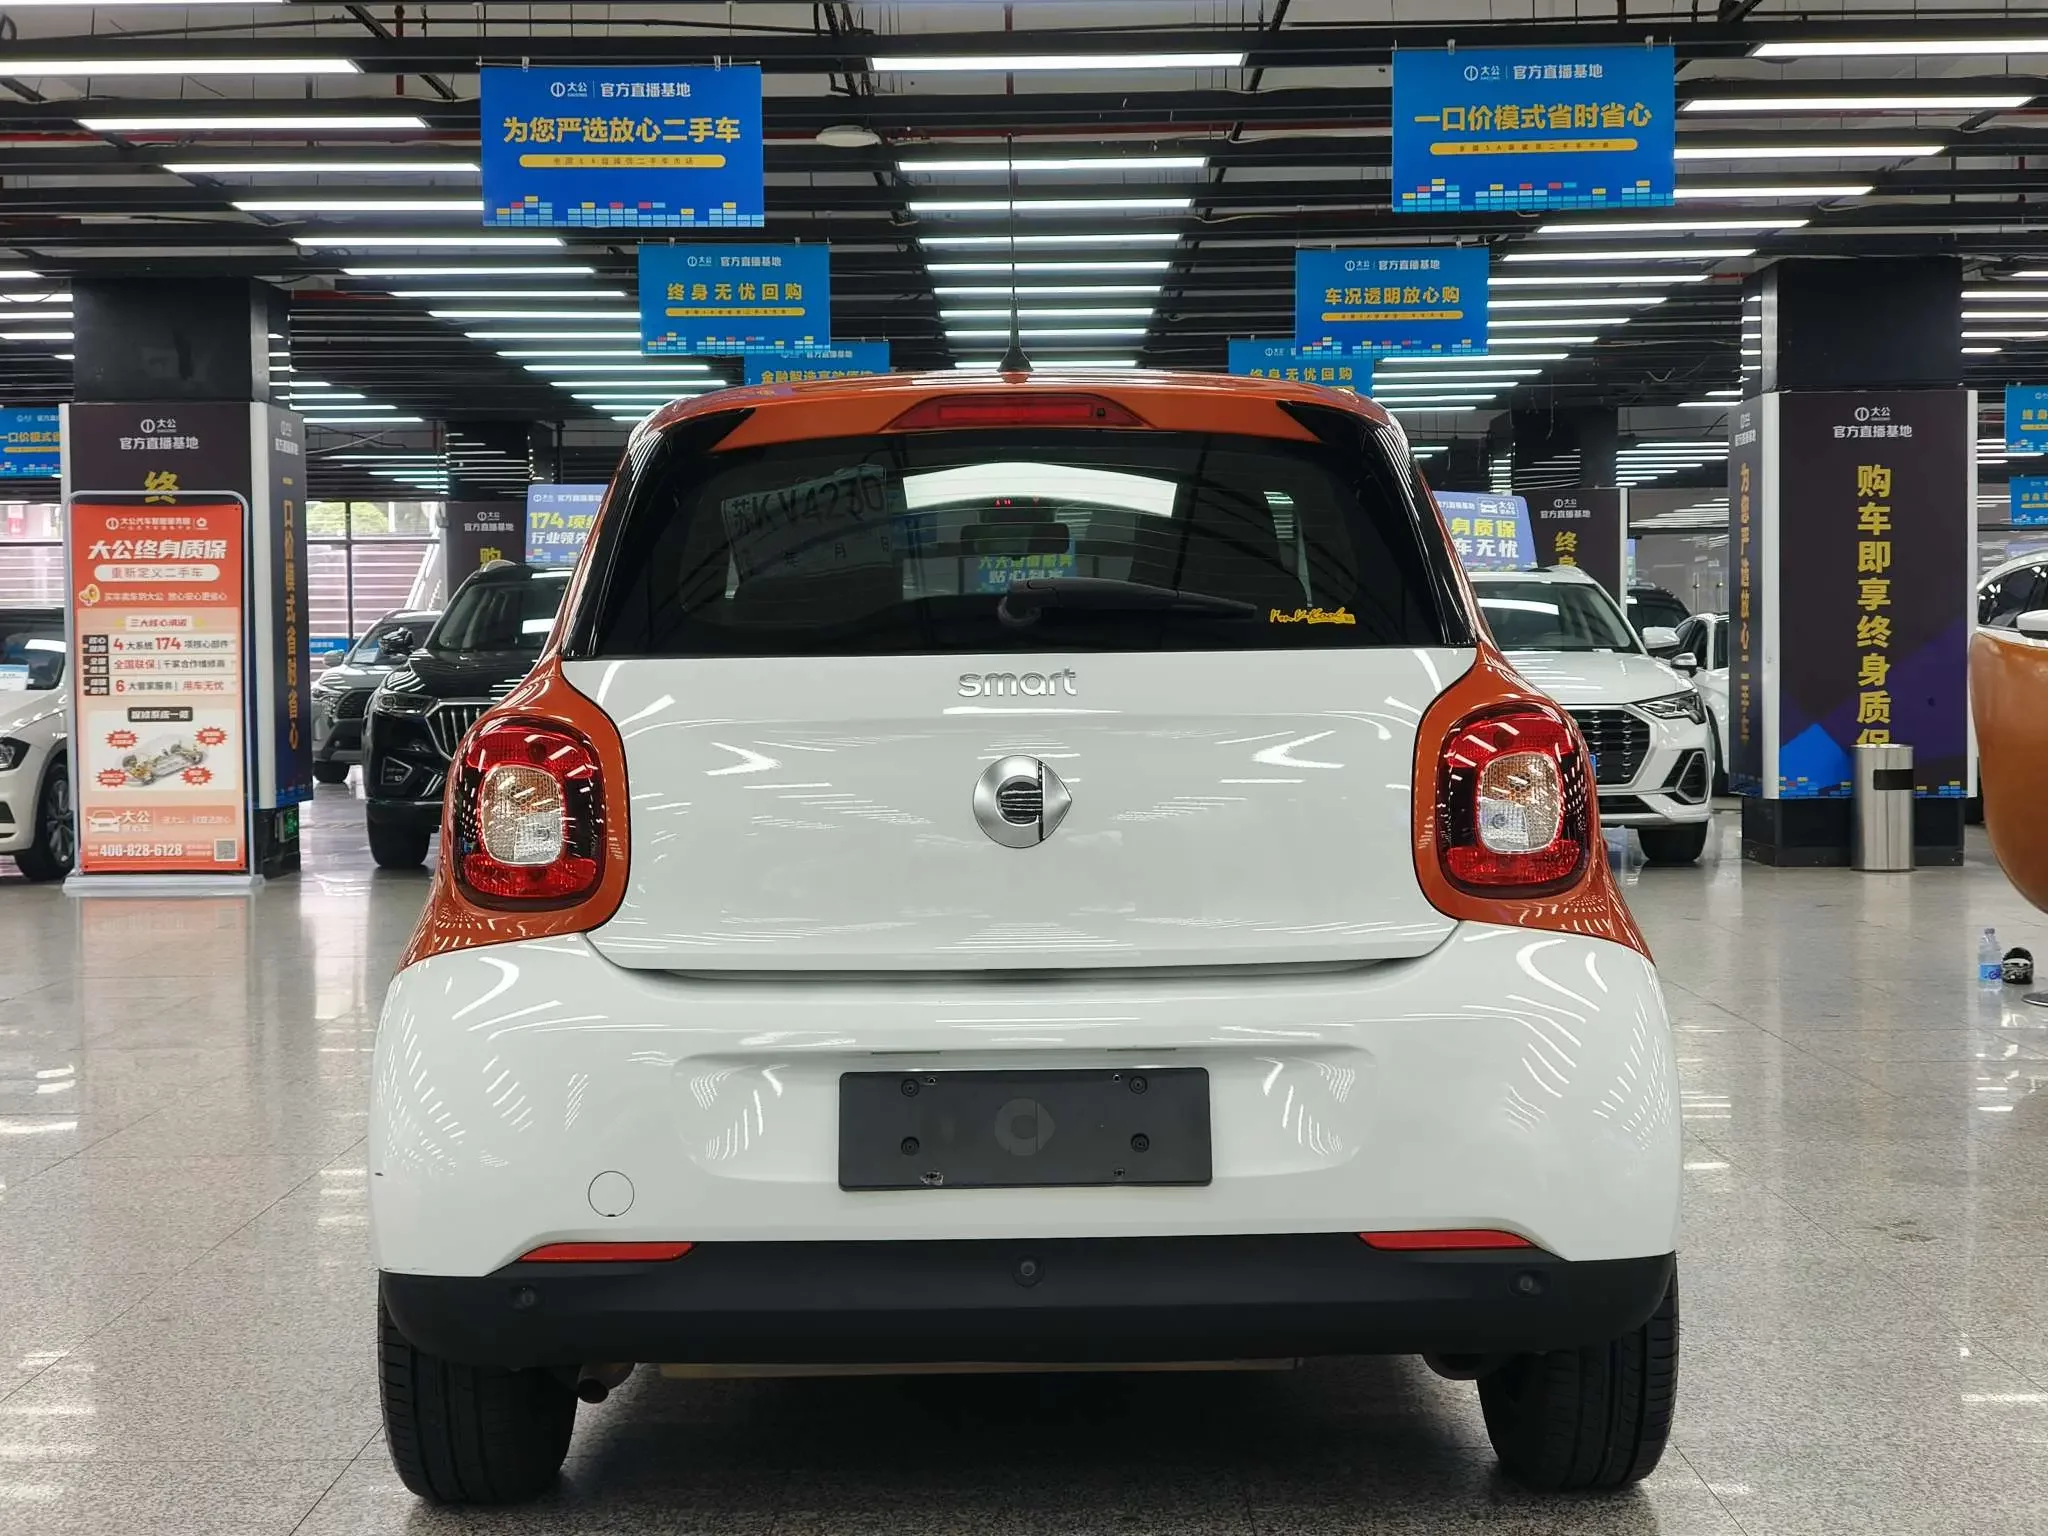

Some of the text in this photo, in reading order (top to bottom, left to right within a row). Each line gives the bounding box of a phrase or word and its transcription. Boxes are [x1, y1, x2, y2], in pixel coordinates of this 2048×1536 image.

[1480, 63, 1604, 81] 大公 官方直播基地
[567, 81, 692, 99] 大公 官方直播基地
[1413, 102, 1653, 132] 一口价模式省时省心
[503, 115, 742, 144] 为您严选放心二手车
[720, 255, 783, 268] 官方直播基地
[1378, 259, 1441, 272] 官方直播基地
[667, 282, 803, 301] 终身无忧回购
[1324, 286, 1460, 305] 车况透明放心购
[1870, 406, 1891, 417] 大公
[157, 418, 177, 429] 大公
[1832, 425, 1913, 439] 官方直播基地
[119, 436, 200, 450] 官方直播基地
[144, 470, 180, 505] 终
[529, 511, 565, 530] 174
[1540, 509, 1592, 520] 官方直播基地
[463, 522, 515, 533] 官方直播基地
[1451, 517, 1517, 539] 身质保
[87, 539, 229, 560] 大公终身质保
[479, 546, 502, 568] 购
[111, 567, 204, 579] 重新定义二手车
[113, 637, 124, 651] 4
[155, 637, 181, 651] 174
[115, 679, 125, 693] 6
[957, 666, 1079, 698] smart
[121, 810, 151, 824] 大公
[99, 843, 184, 858] 400-828-6128
